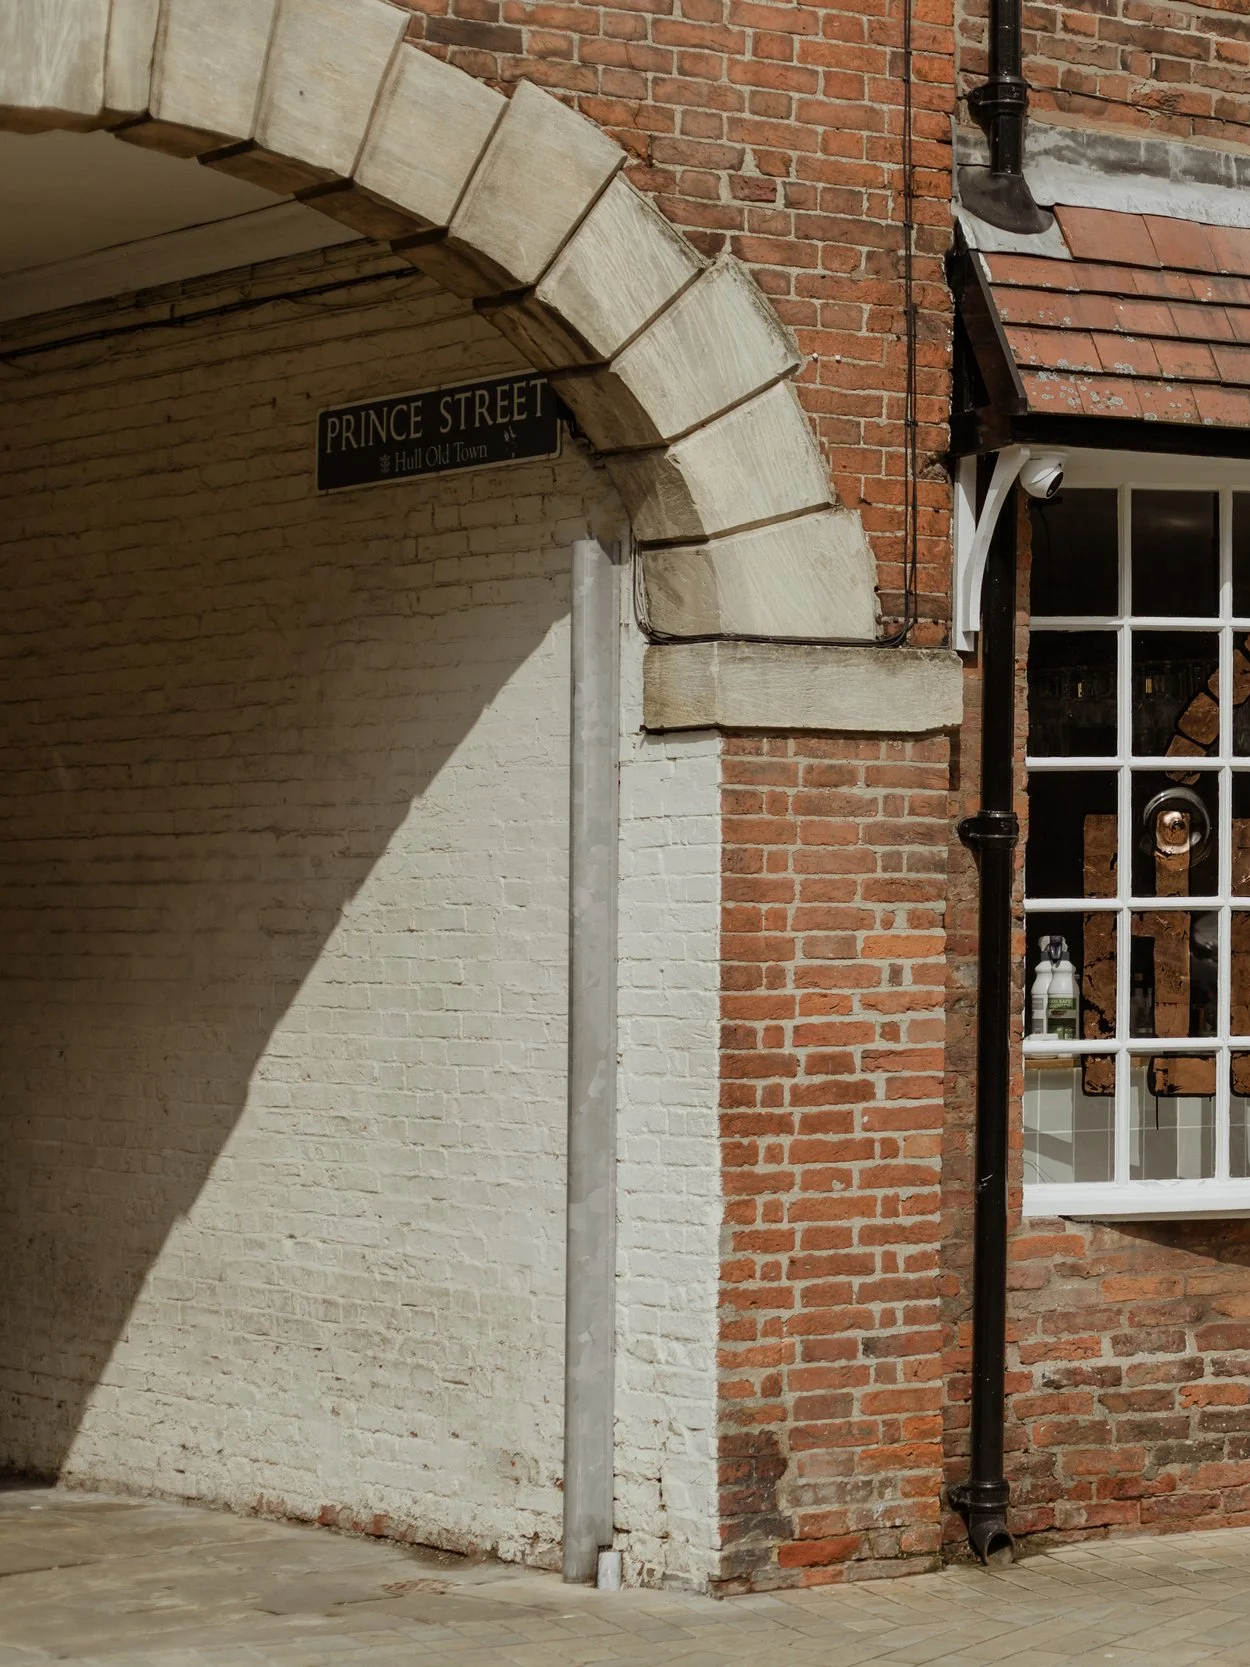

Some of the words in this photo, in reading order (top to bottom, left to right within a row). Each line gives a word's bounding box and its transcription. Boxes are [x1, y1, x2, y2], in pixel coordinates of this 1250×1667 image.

[326, 400, 423, 453] PRINCE
[440, 378, 548, 434] STREET
[395, 452, 422, 472] Hull
[425, 444, 450, 467] Old
[453, 441, 488, 463] Town
